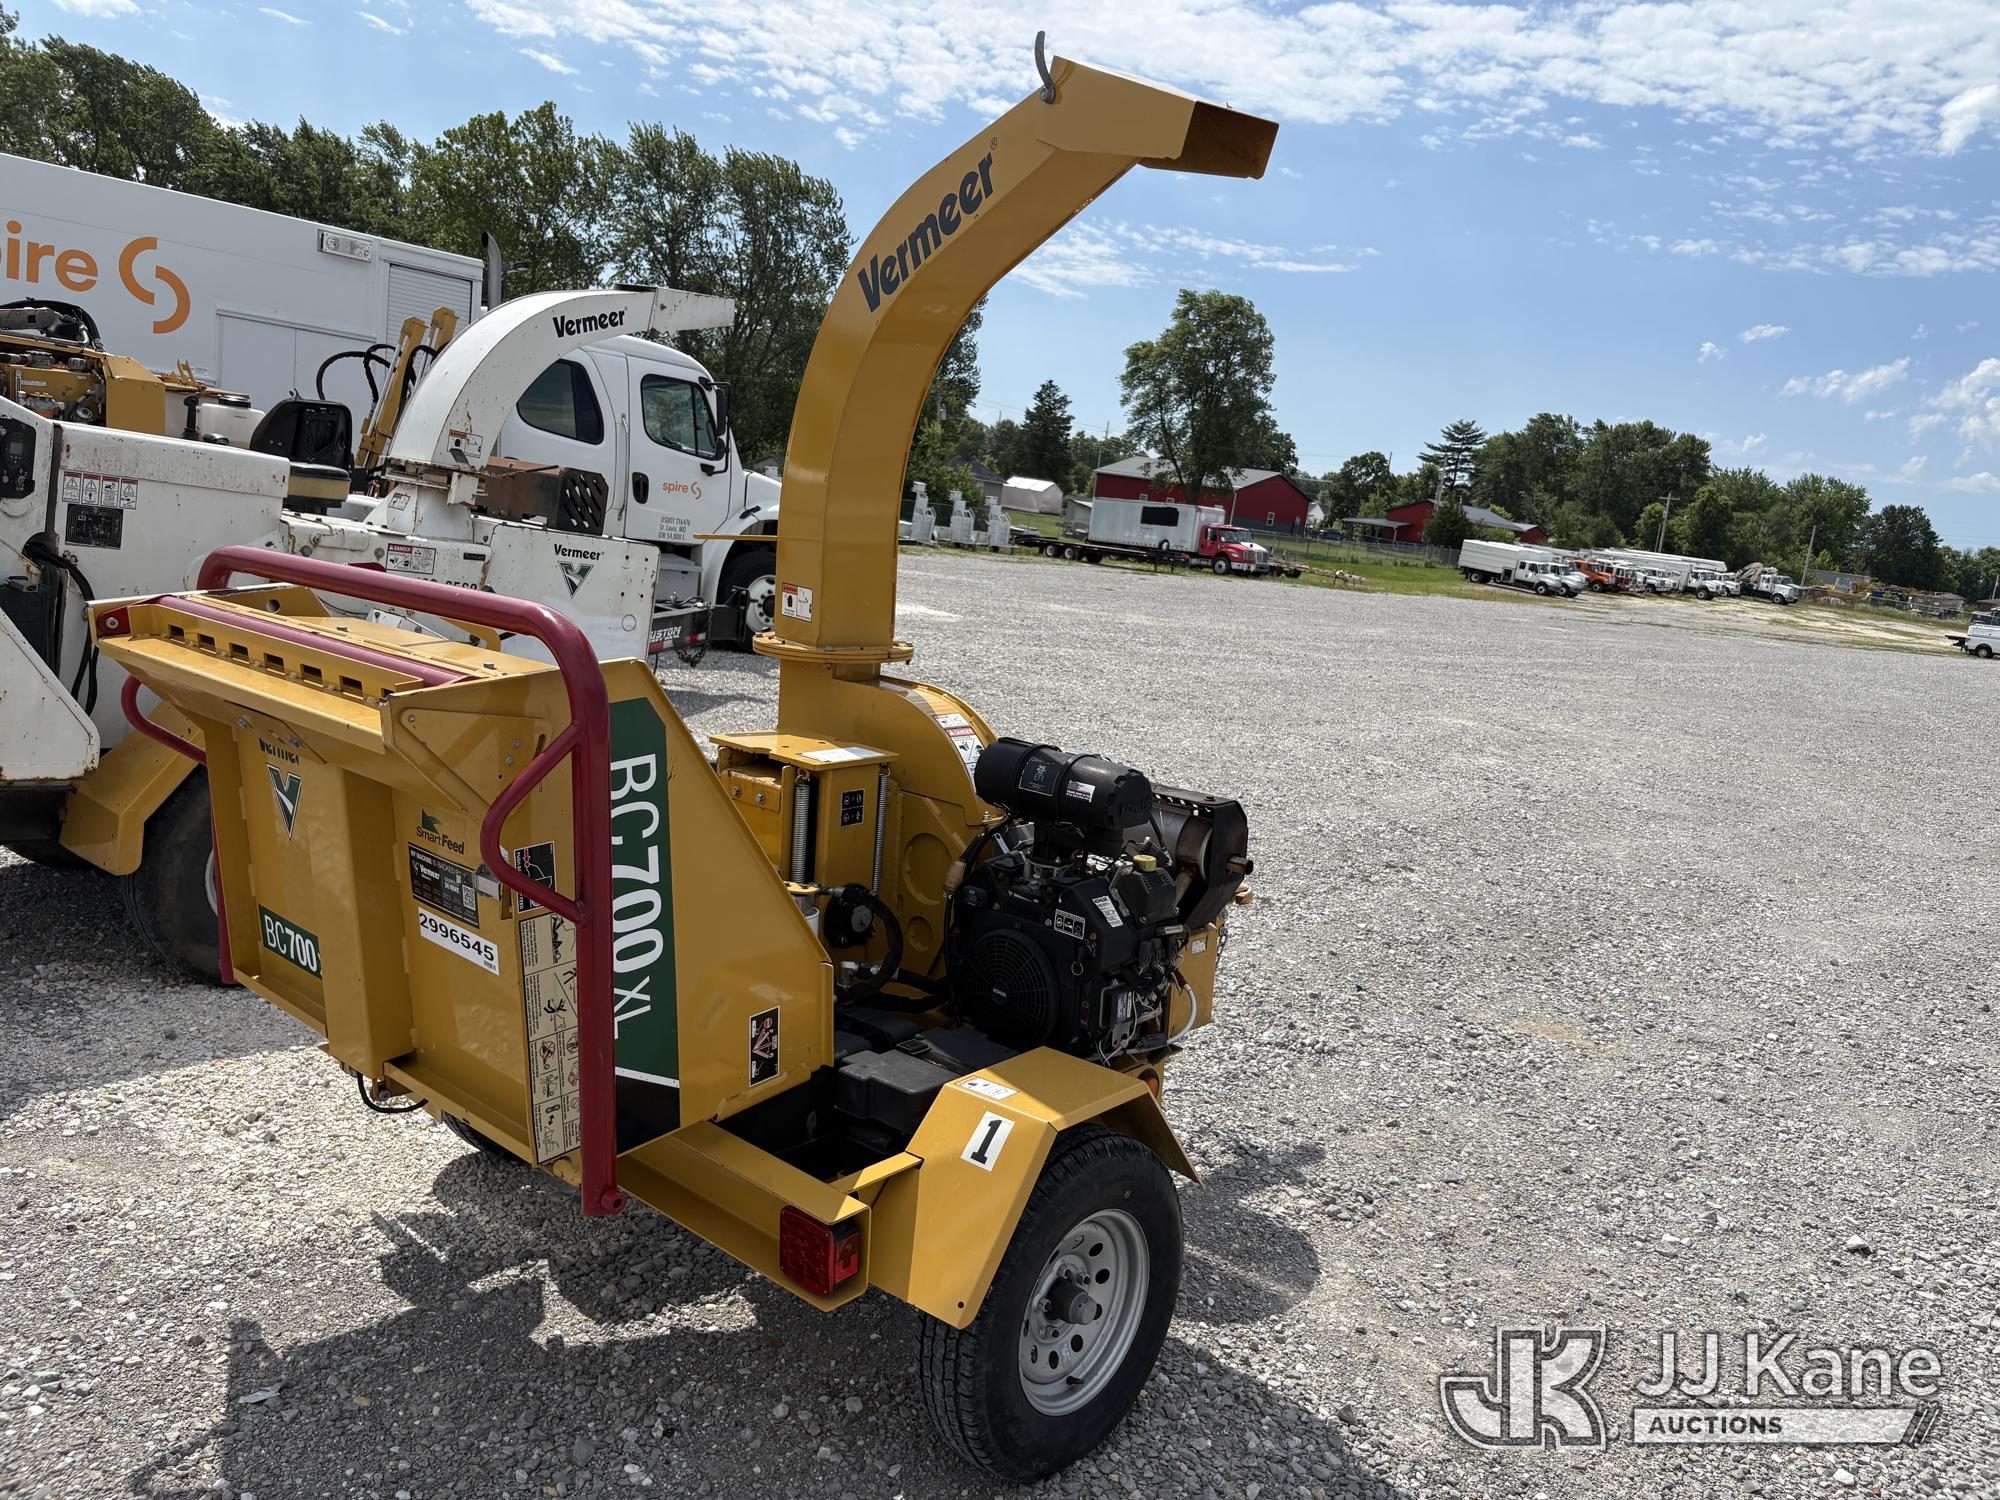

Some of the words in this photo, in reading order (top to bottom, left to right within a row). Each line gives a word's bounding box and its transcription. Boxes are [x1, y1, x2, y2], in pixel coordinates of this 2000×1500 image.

[0, 220, 98, 292] ire
[662, 481, 689, 494] spire
[651, 626, 681, 640] USTOM
[264, 914, 318, 973] BC700
[419, 912, 495, 962] 2996545
[970, 1119, 1003, 1165] 1
